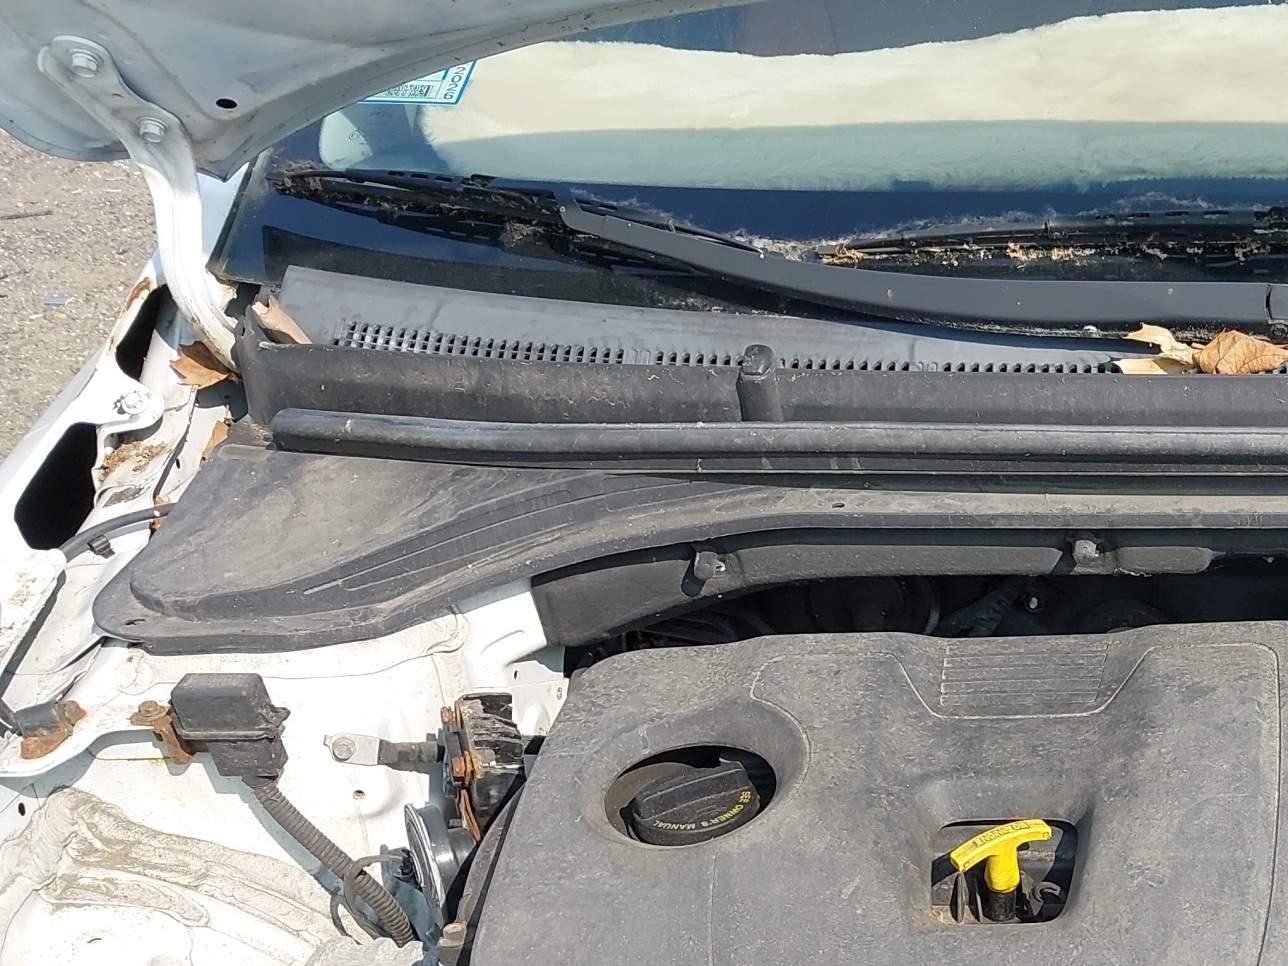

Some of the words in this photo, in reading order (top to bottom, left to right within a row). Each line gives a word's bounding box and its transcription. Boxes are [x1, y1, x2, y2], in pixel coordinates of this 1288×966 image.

[443, 66, 467, 100] 2026
[651, 819, 697, 831] MANUAL
[699, 803, 745, 829] OWNER'S
